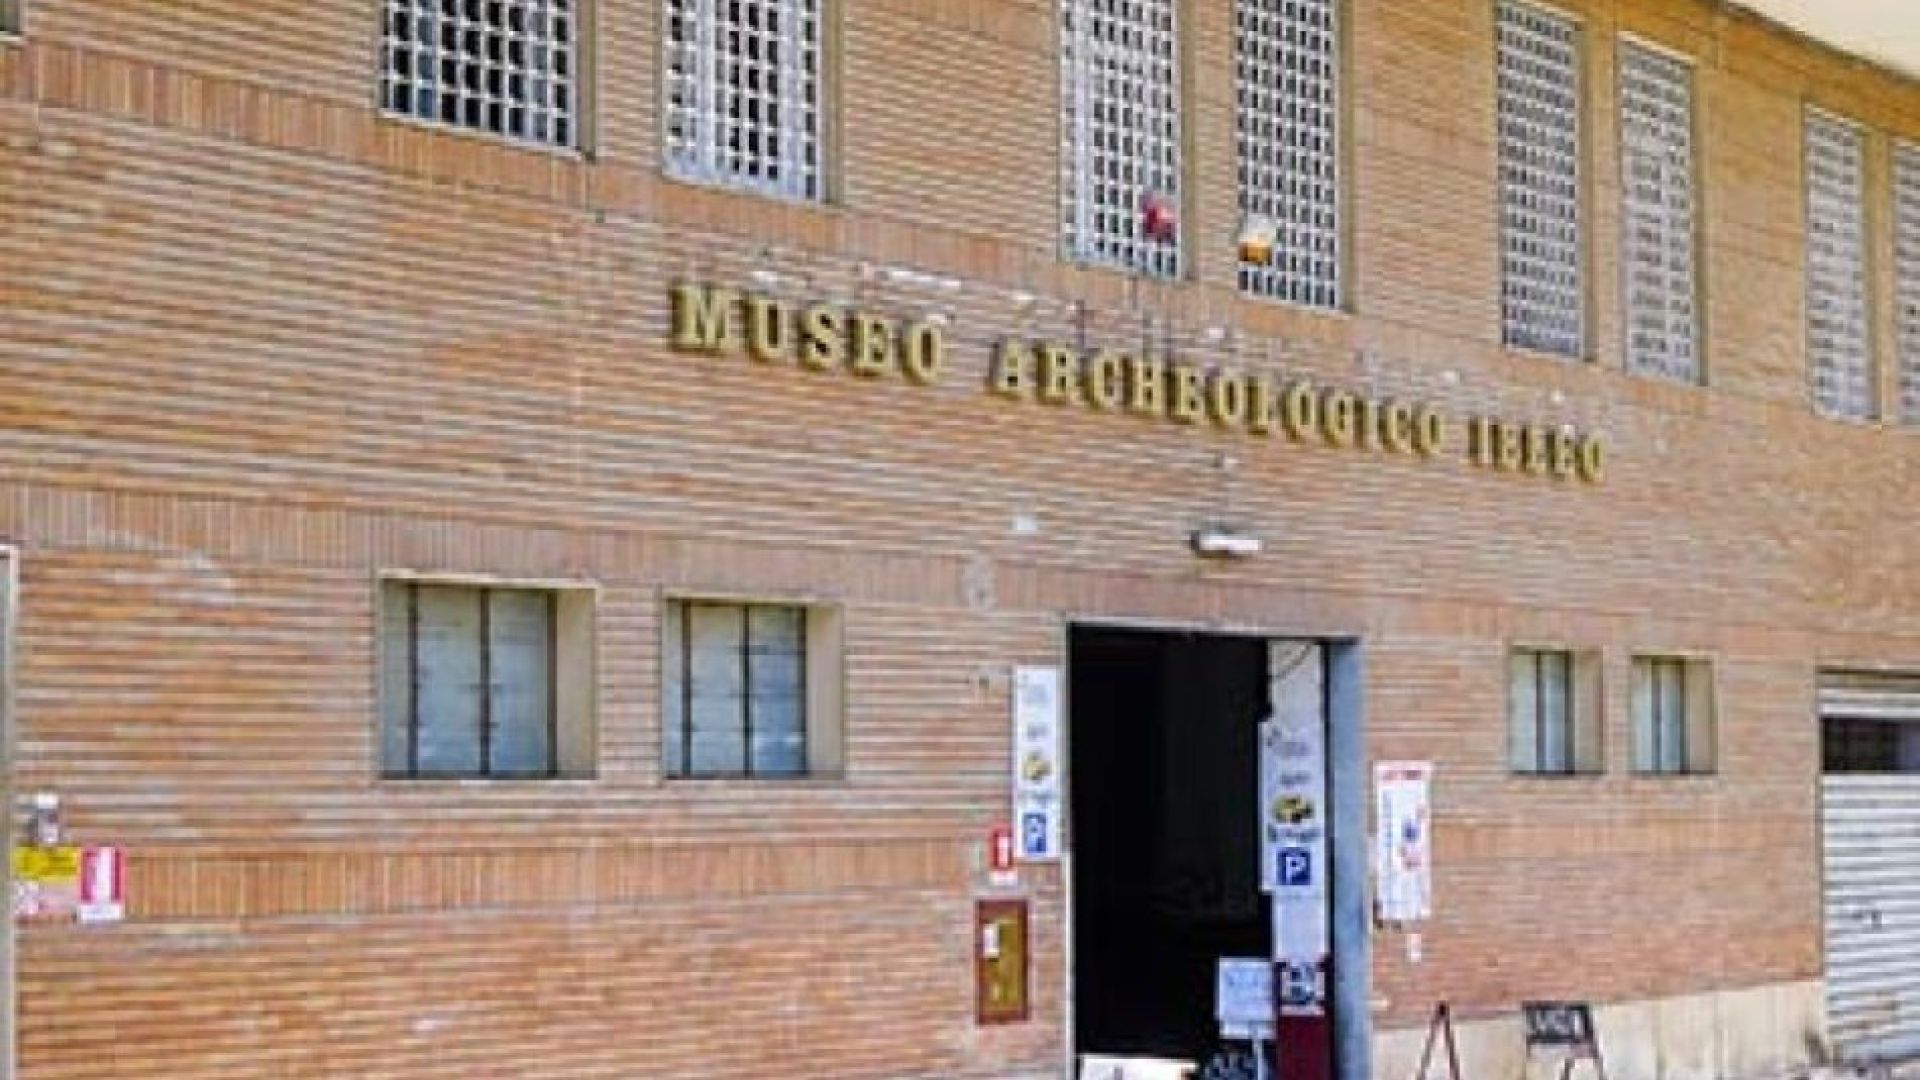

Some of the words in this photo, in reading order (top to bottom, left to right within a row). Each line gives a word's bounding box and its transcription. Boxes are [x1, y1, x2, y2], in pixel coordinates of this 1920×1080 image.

[673, 284, 947, 384] MUSEO
[990, 338, 1447, 457] ARCHEOLOGICO
[1284, 854, 1308, 885] P
